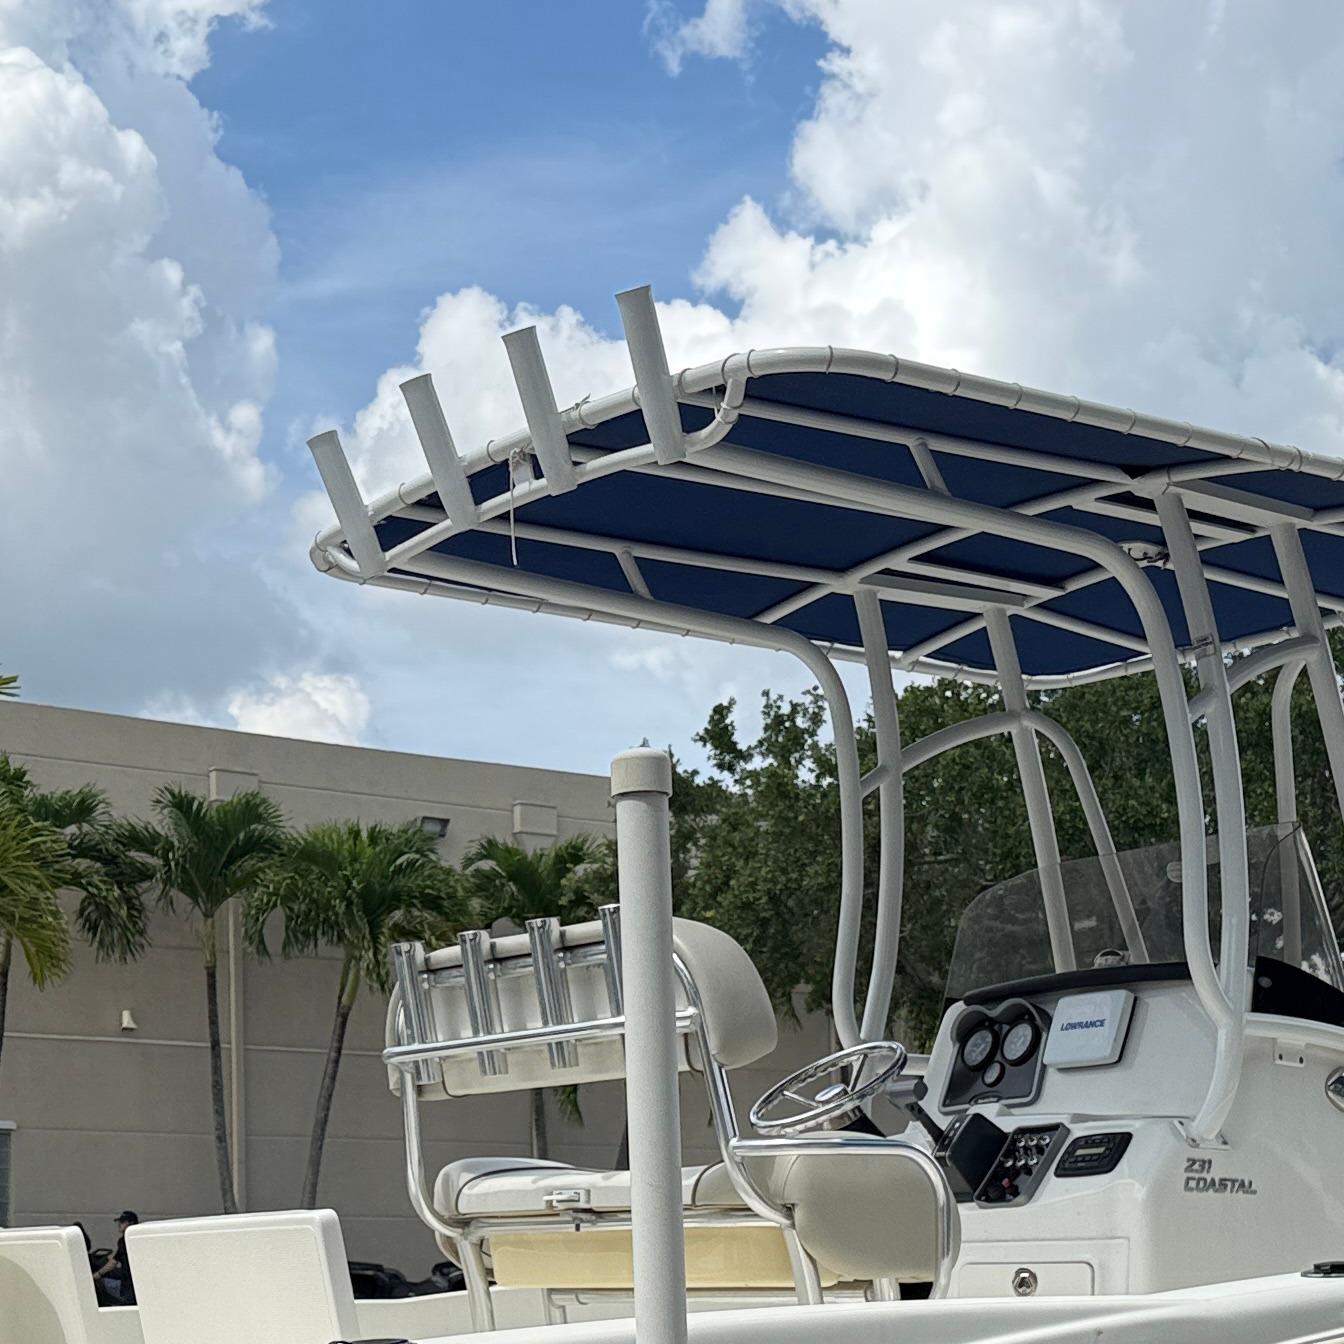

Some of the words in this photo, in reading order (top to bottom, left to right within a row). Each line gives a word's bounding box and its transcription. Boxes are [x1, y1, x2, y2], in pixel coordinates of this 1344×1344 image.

[1060, 1018, 1106, 1031] LOWRANCE
[1184, 1156, 1213, 1174] 231
[1184, 1175, 1258, 1196] COASTAL
